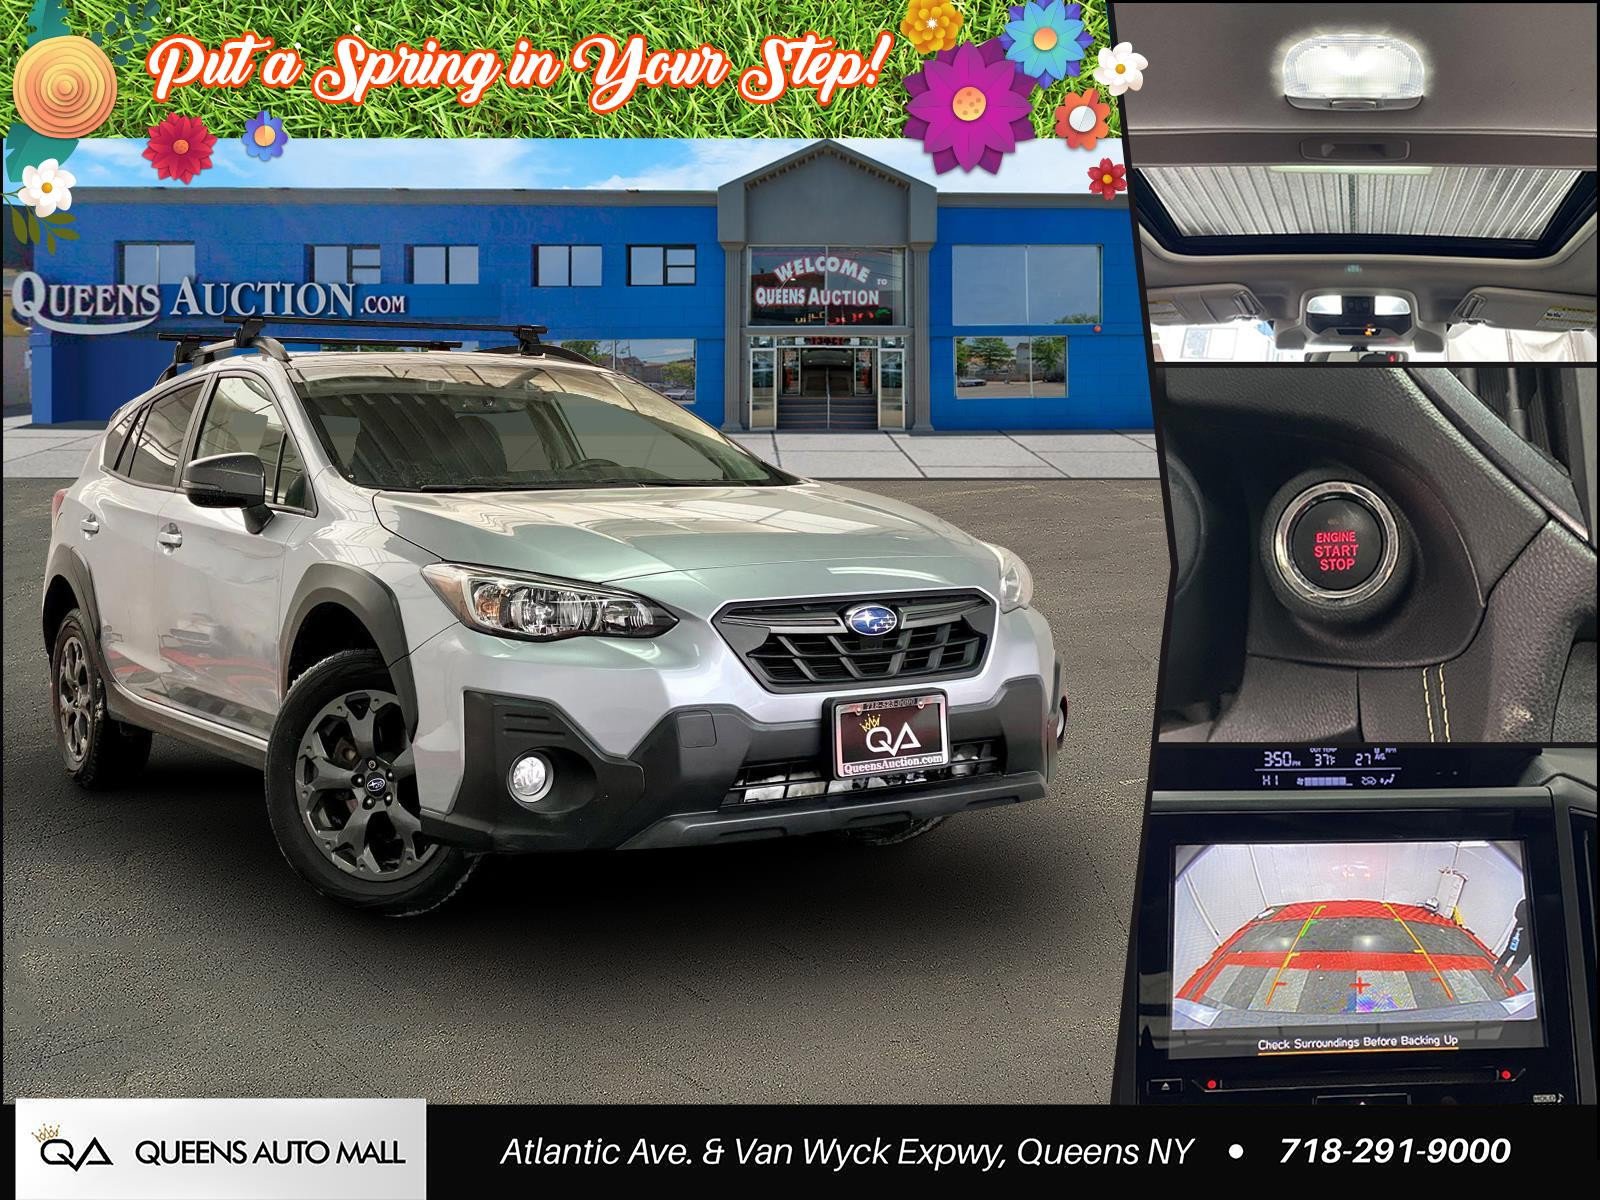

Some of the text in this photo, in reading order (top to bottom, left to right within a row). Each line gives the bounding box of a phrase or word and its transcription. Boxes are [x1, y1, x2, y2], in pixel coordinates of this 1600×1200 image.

[774, 256, 872, 283] WELCOME
[755, 287, 880, 307] QUEENS AUCTION
[1316, 531, 1356, 543] ENGINE
[1314, 544, 1359, 558] START
[1320, 558, 1355, 570] STOP
[844, 754, 943, 774] QueensAuction.com
[1355, 753, 1372, 766] 27
[1258, 1034, 1459, 1051] Check Surroundings Before Backing Up
